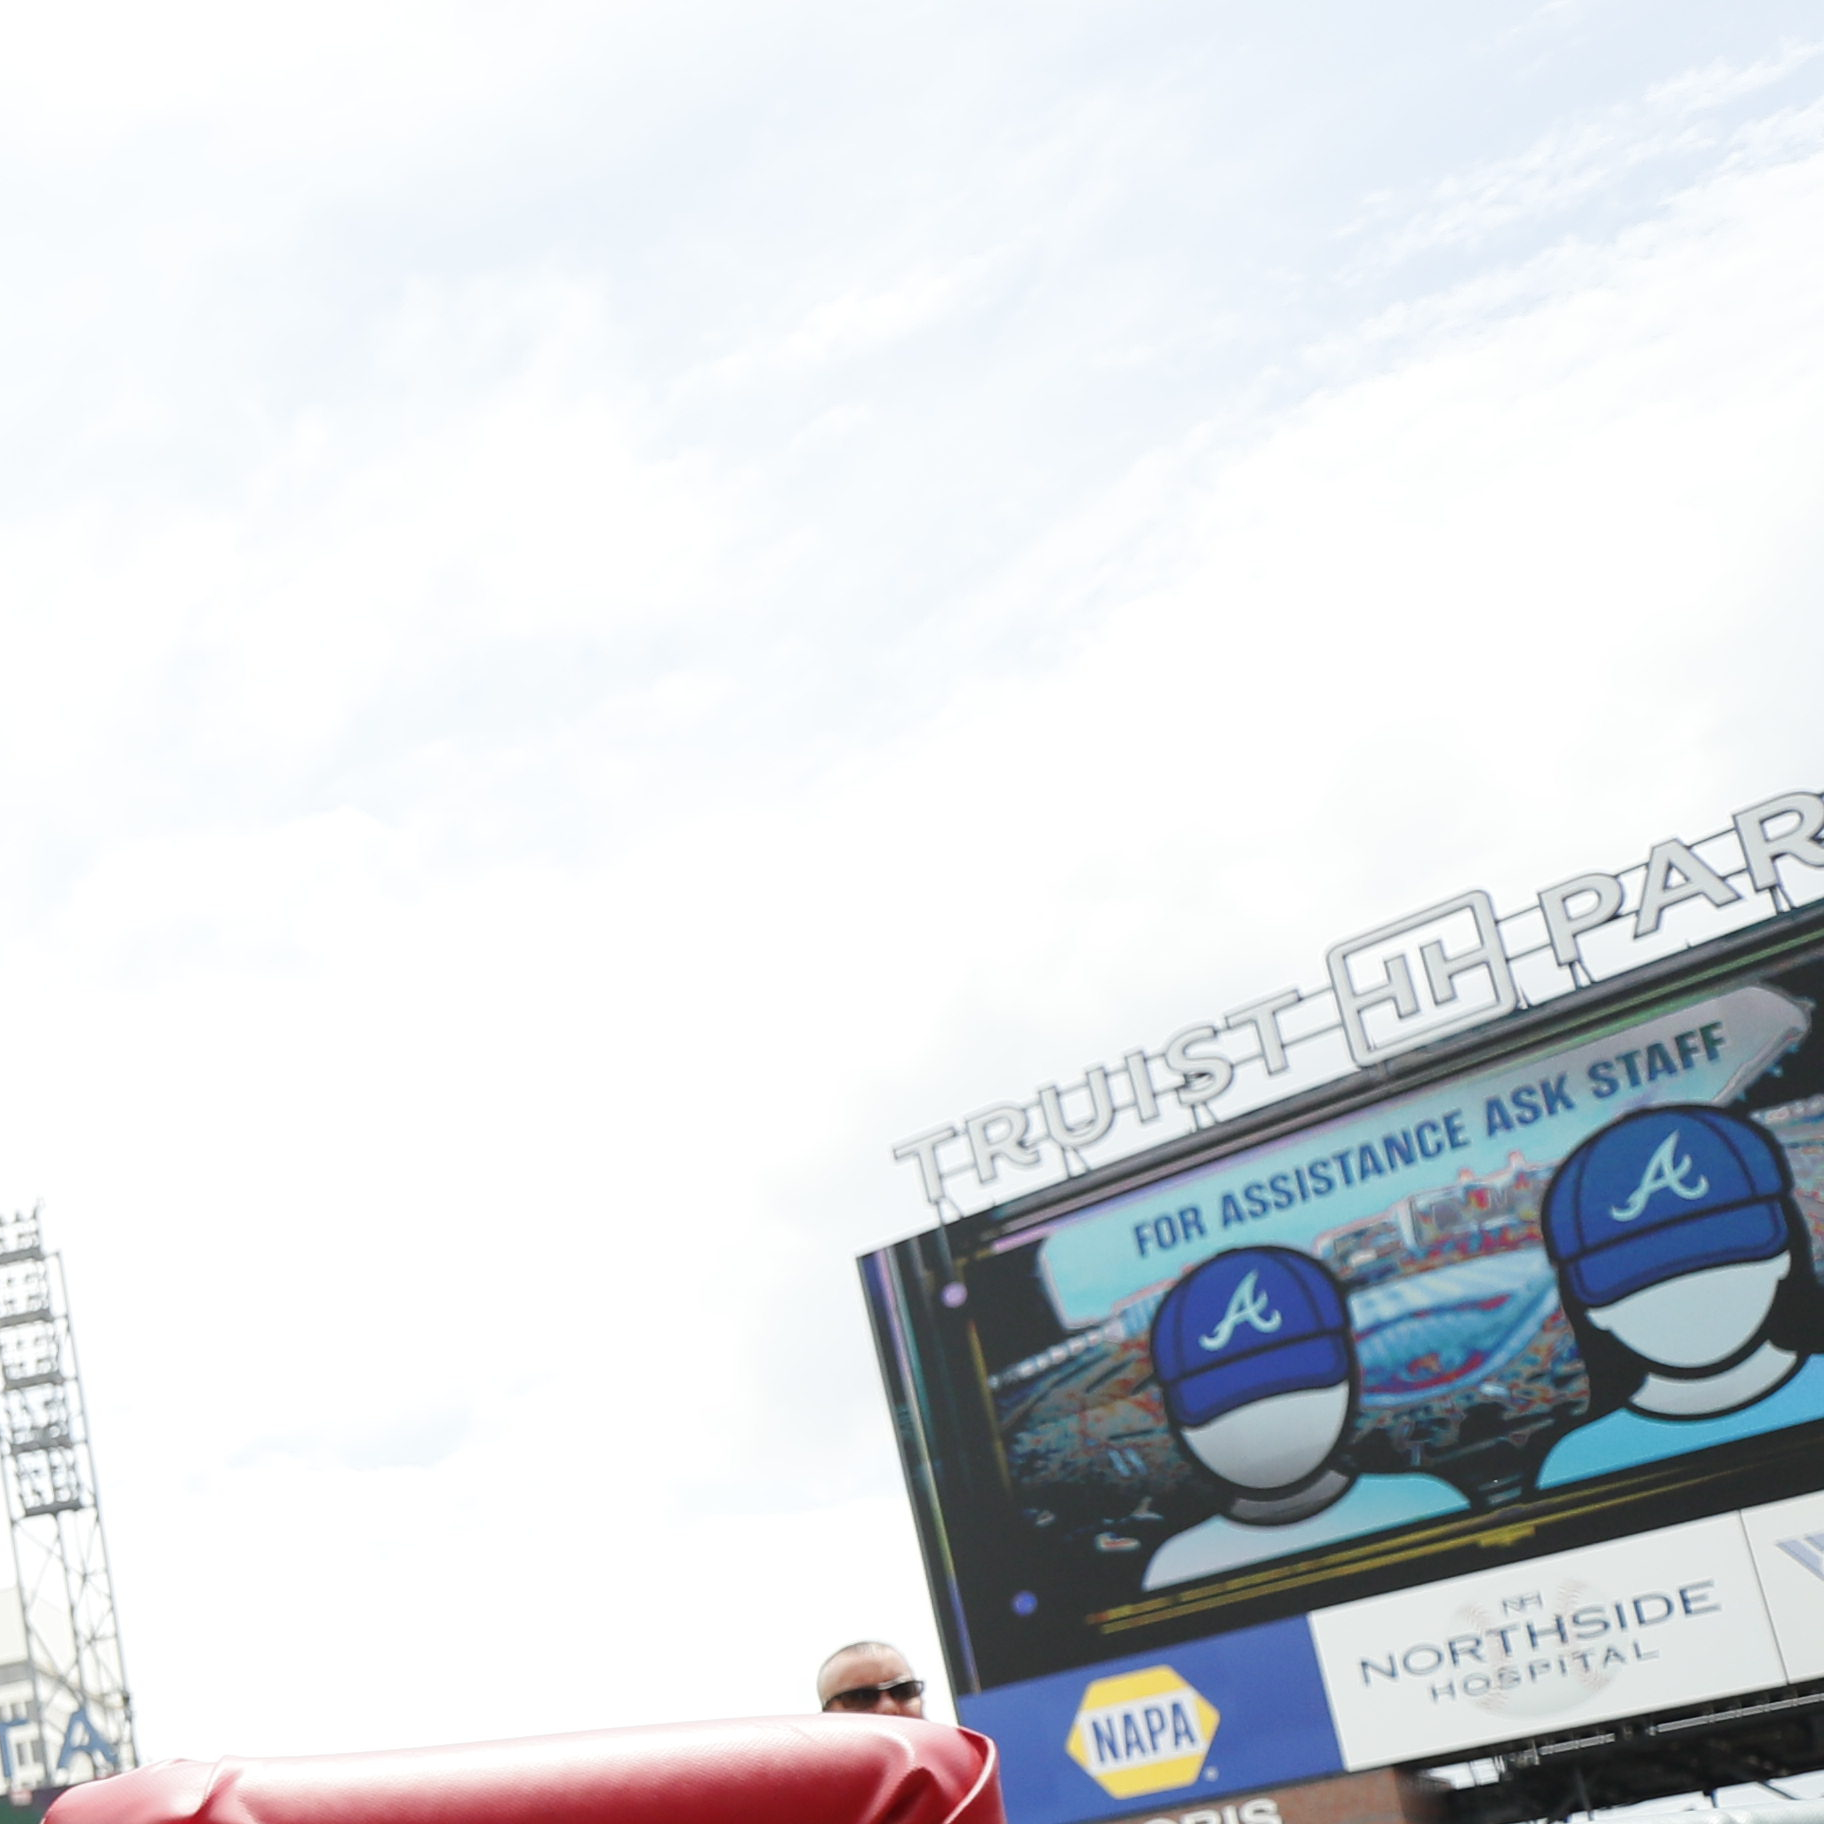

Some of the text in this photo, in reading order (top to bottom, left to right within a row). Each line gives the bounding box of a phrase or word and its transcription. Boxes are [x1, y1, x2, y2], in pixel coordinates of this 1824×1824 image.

[892, 989, 1303, 1204] TRUIST
[1132, 1020, 1729, 1258] FOR ASSISTANCE ASK STAFF
[1360, 1579, 1722, 1687] NORTHSIDE
[1429, 1640, 1660, 1703] HOSPITAL
[1092, 1702, 1196, 1763] NAPA
